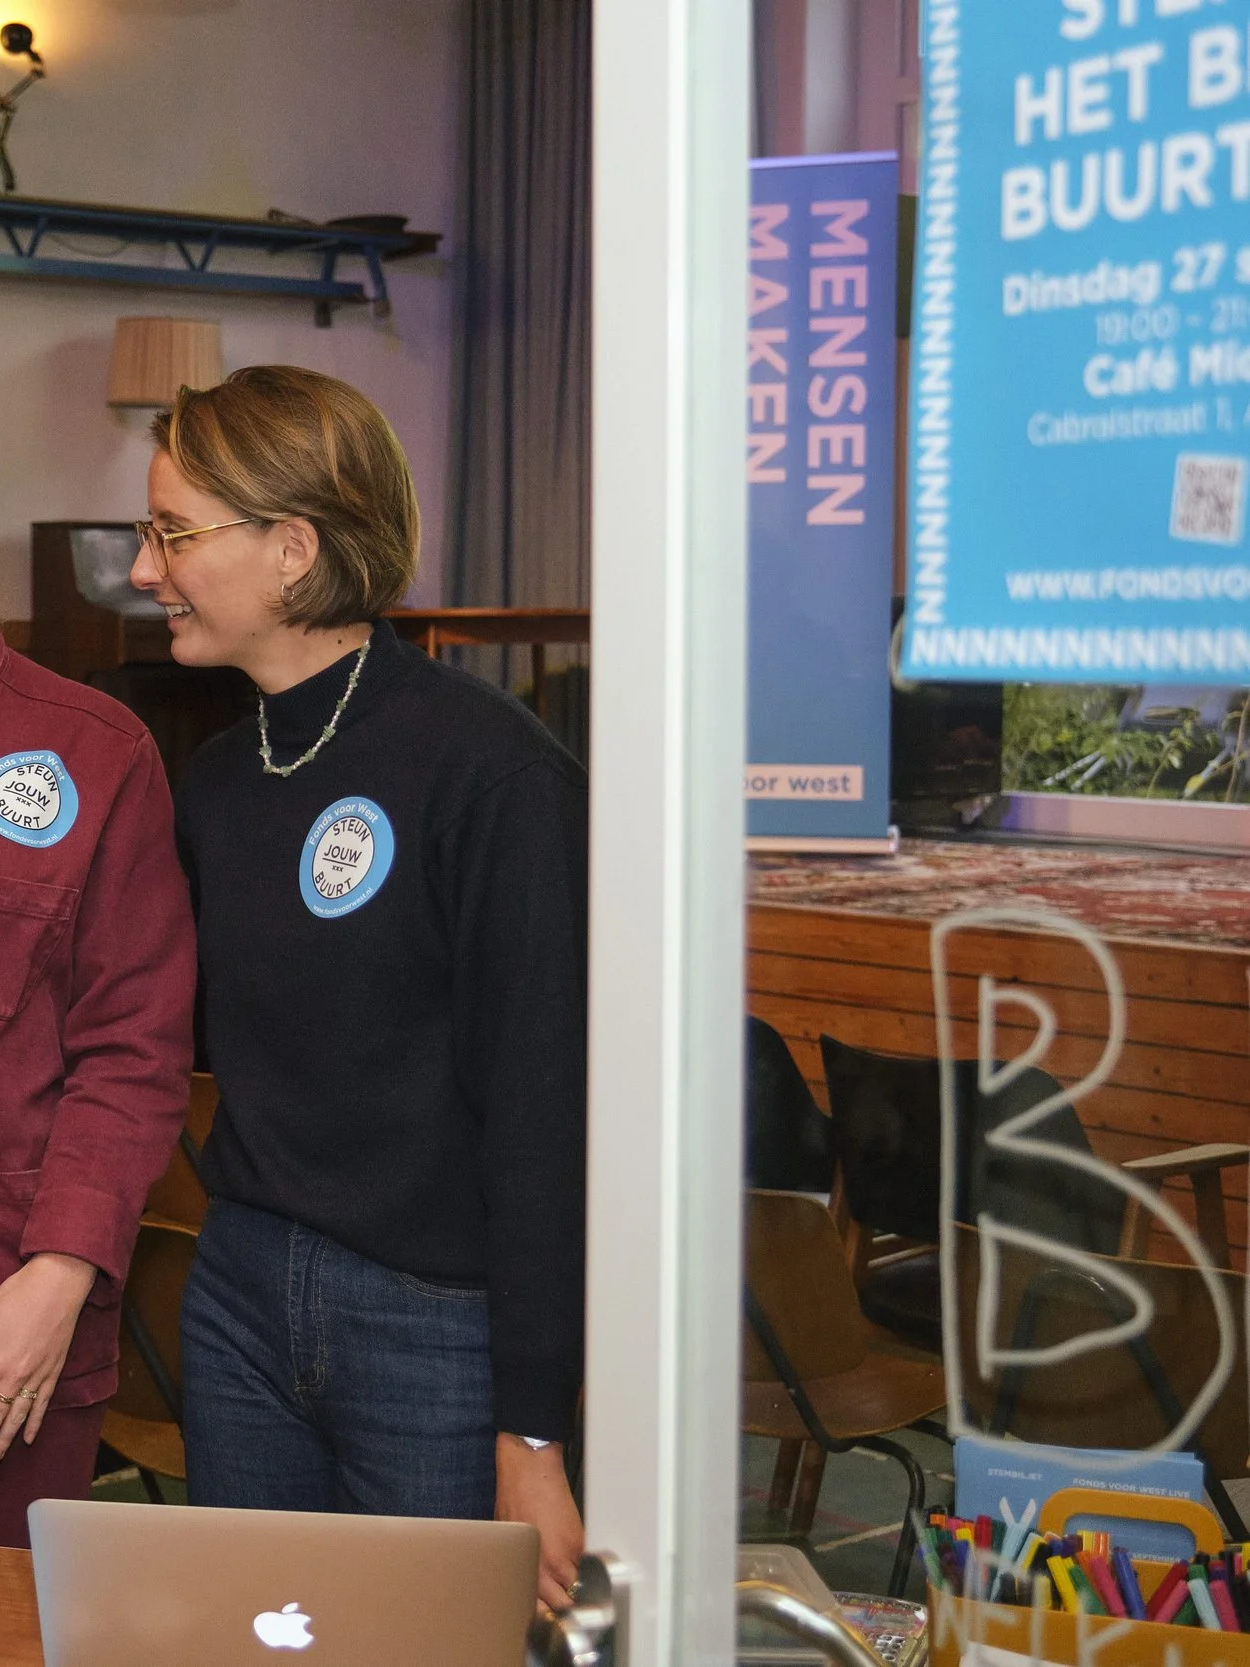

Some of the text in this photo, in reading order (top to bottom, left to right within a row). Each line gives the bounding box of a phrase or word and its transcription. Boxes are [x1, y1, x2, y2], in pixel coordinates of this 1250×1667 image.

[1014, 22, 1250, 146] HET B
[1001, 120, 1250, 241] BUURT
[1003, 261, 1161, 317] Dinsdag
[1170, 242, 1227, 292] 27
[746, 204, 790, 484] MAKEN
[806, 199, 869, 525] MENSEN
[1083, 345, 1177, 399] Café
[1006, 566, 1250, 600] WWW.FONDSVO
[16, 765, 57, 792] STEUN
[19, 755, 44, 763] voor
[47, 755, 66, 781] West
[5, 781, 50, 807] JOUW
[788, 774, 850, 793] west
[308, 803, 379, 845] Fonds voor West
[333, 819, 370, 842] STEUN
[324, 844, 362, 863] JOUW
[315, 871, 352, 897] BUURT
[987, 1468, 1043, 1481] STEMBILJET
[1072, 1477, 1190, 1499] FONDS VOOR WEST LIVE
